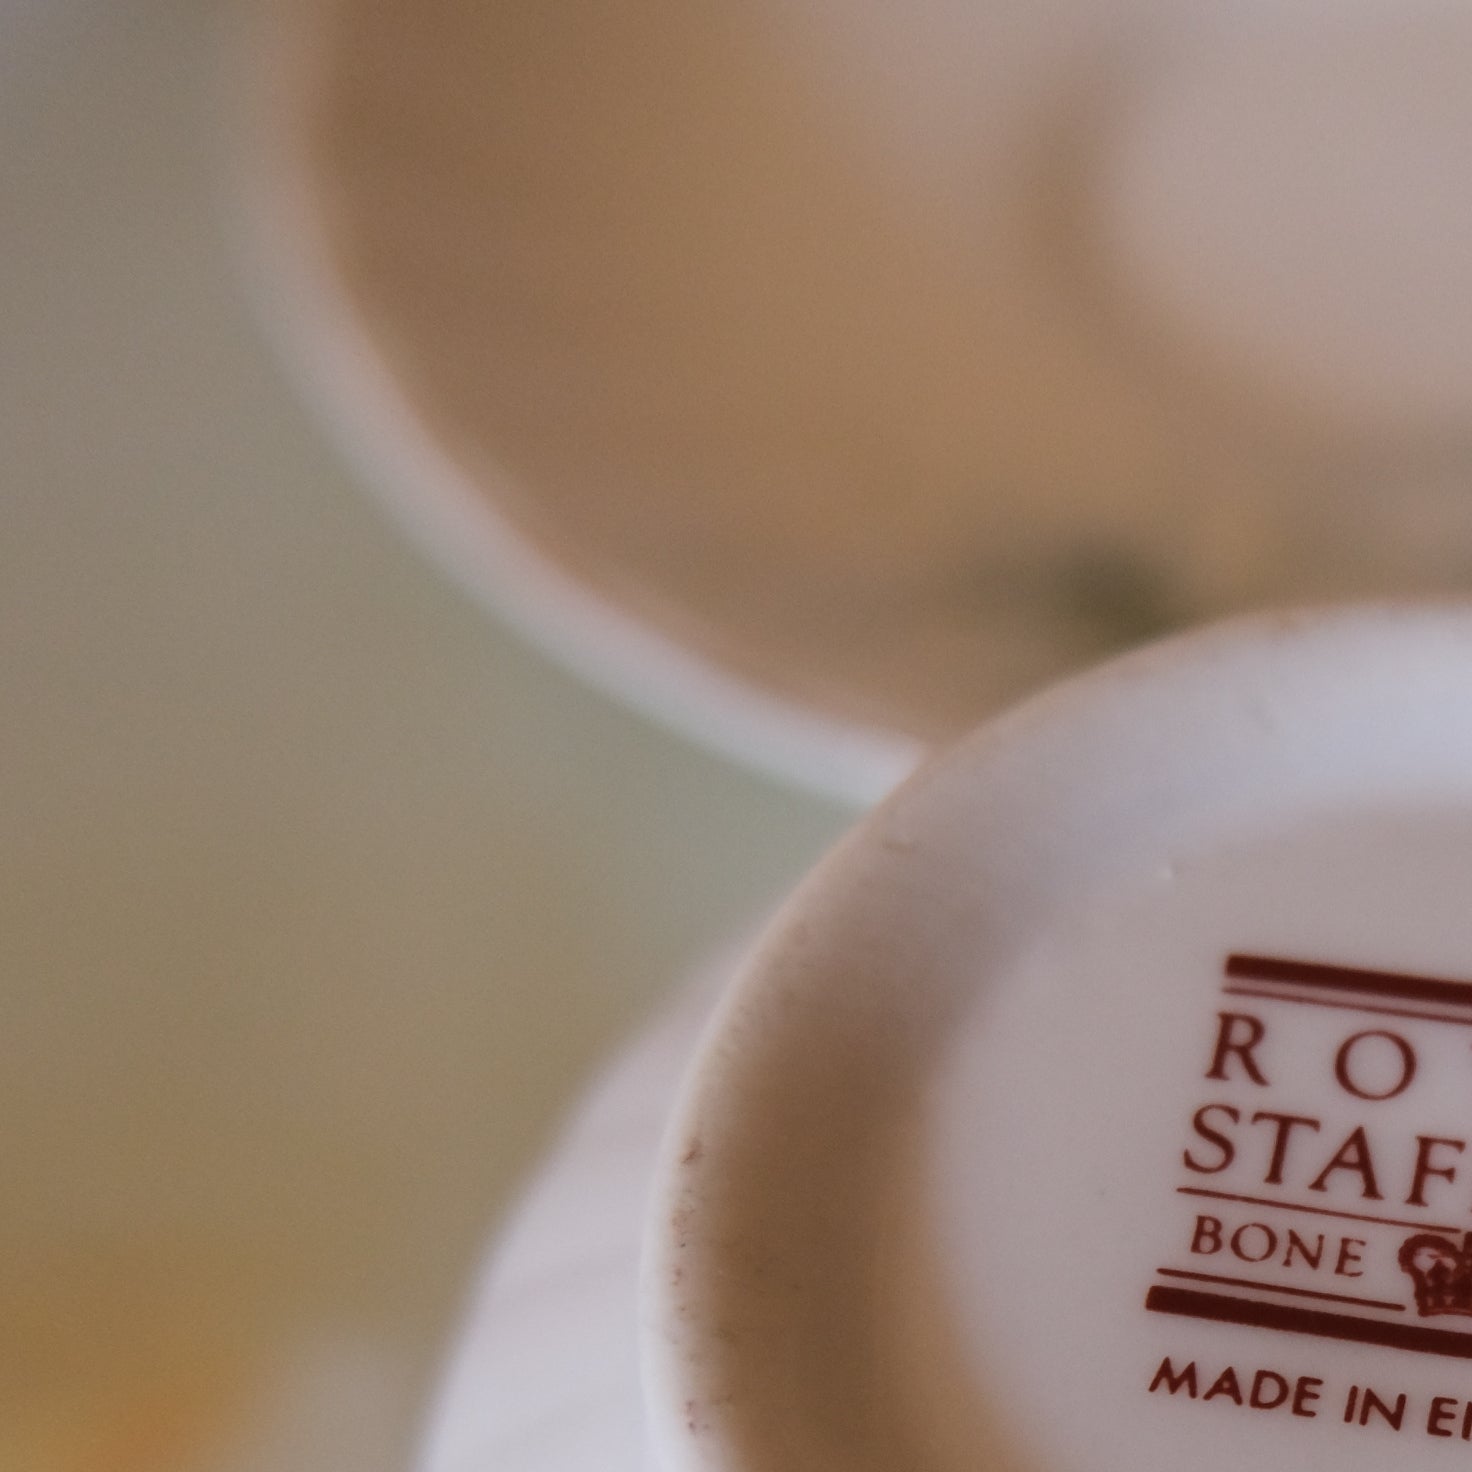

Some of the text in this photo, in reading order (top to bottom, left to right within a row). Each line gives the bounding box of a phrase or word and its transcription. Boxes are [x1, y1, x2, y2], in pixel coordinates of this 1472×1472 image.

[1189, 1214, 1368, 1278] BONE
[1148, 1356, 1325, 1418] MADE
[1343, 1385, 1407, 1432] IN
